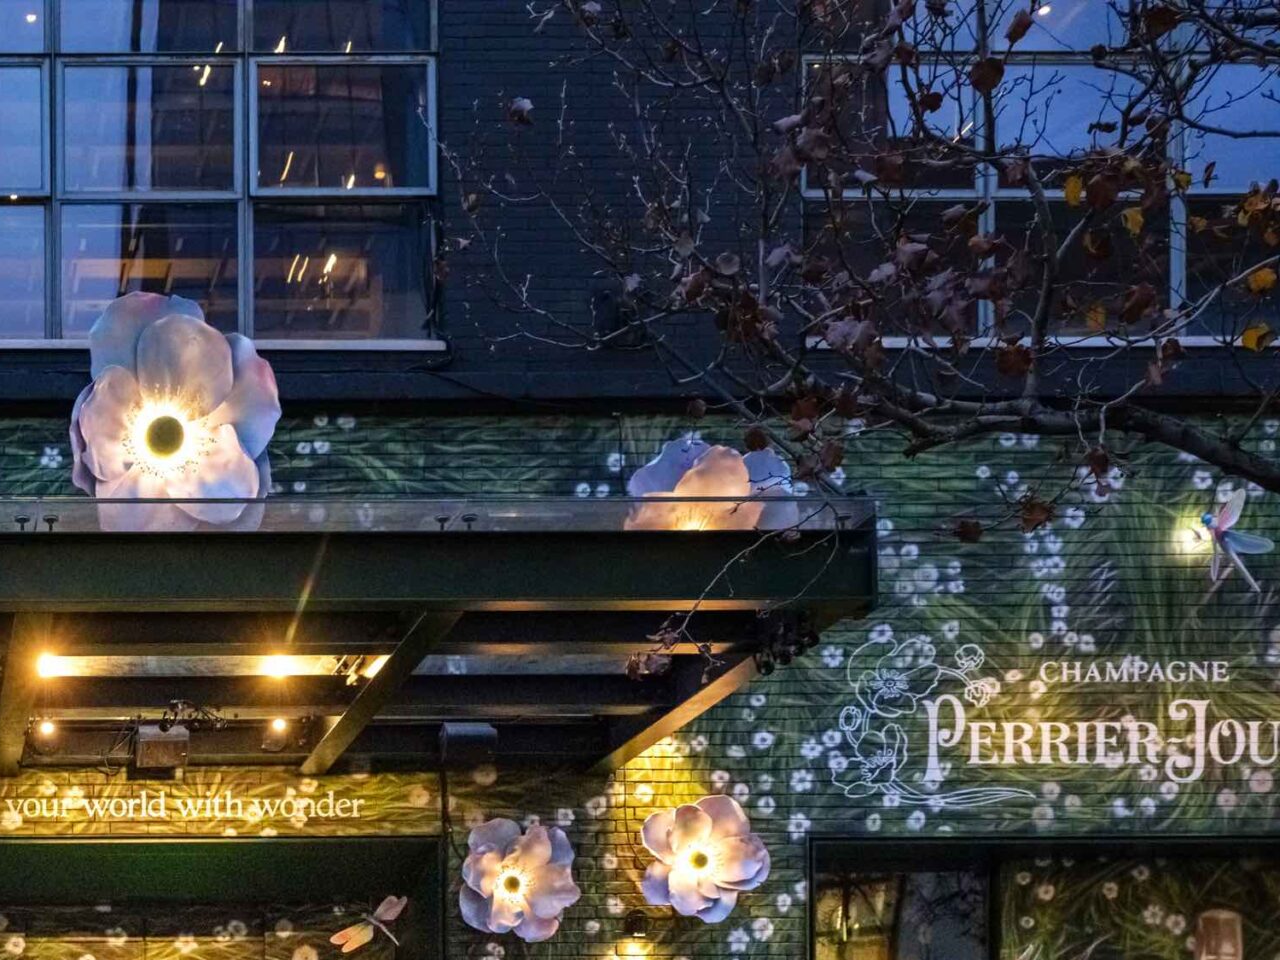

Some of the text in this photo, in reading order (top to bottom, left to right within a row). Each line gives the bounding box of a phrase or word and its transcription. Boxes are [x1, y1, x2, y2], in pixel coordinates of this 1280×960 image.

[1039, 661, 1230, 683] CHAMPAGNE
[6, 797, 71, 826] your
[81, 790, 167, 818] world
[177, 790, 244, 818] with
[252, 790, 365, 819] wonder
